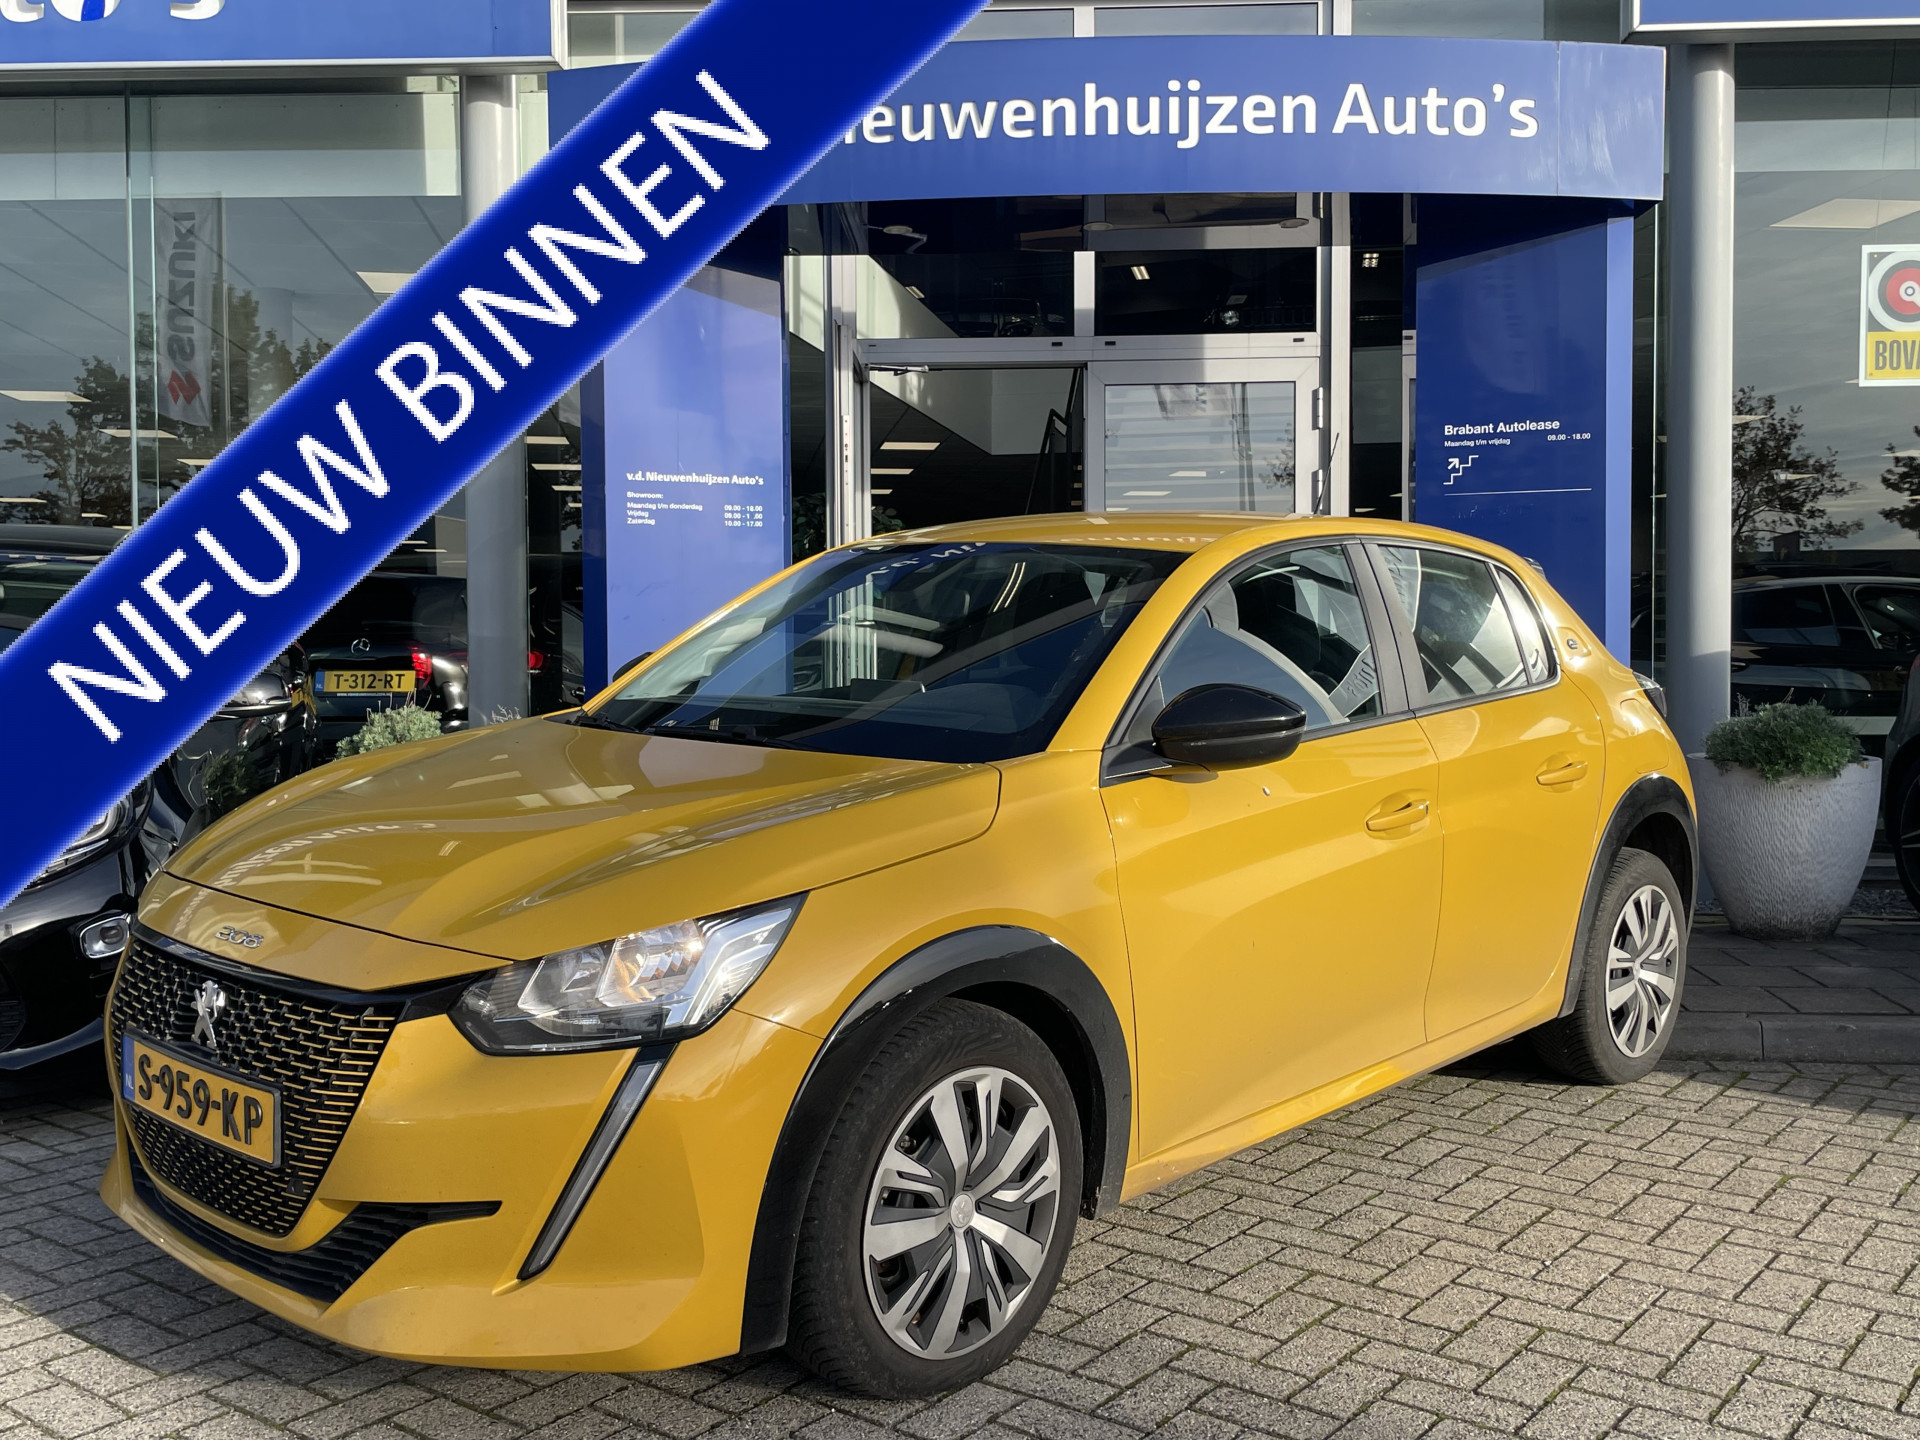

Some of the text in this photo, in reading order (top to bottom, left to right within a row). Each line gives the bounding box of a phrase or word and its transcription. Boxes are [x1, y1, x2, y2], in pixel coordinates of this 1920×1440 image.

[1332, 83, 1540, 138] Auto's
[1874, 340, 1920, 371] BOV
[1444, 420, 1560, 436] Brabant Autolease
[1444, 439, 1475, 447] Maandag
[1475, 438, 1487, 446] t/m
[1488, 437, 1511, 446] vrijdag
[1547, 433, 1567, 441] 09.00
[1572, 432, 1591, 441] 18.00
[626, 471, 764, 486] v.d. Nieuwenhuijzen Auto's
[626, 491, 664, 499] Showroom:
[626, 502, 656, 510] Maandag
[669, 503, 703, 511] donderdag
[626, 510, 649, 518] Vrijdag
[626, 517, 656, 526] Zaterdag
[746, 520, 763, 528] 17.00
[333, 673, 406, 690] T-312-RT
[214, 925, 265, 949] 208
[125, 1053, 264, 1146] NL S-959-KP
